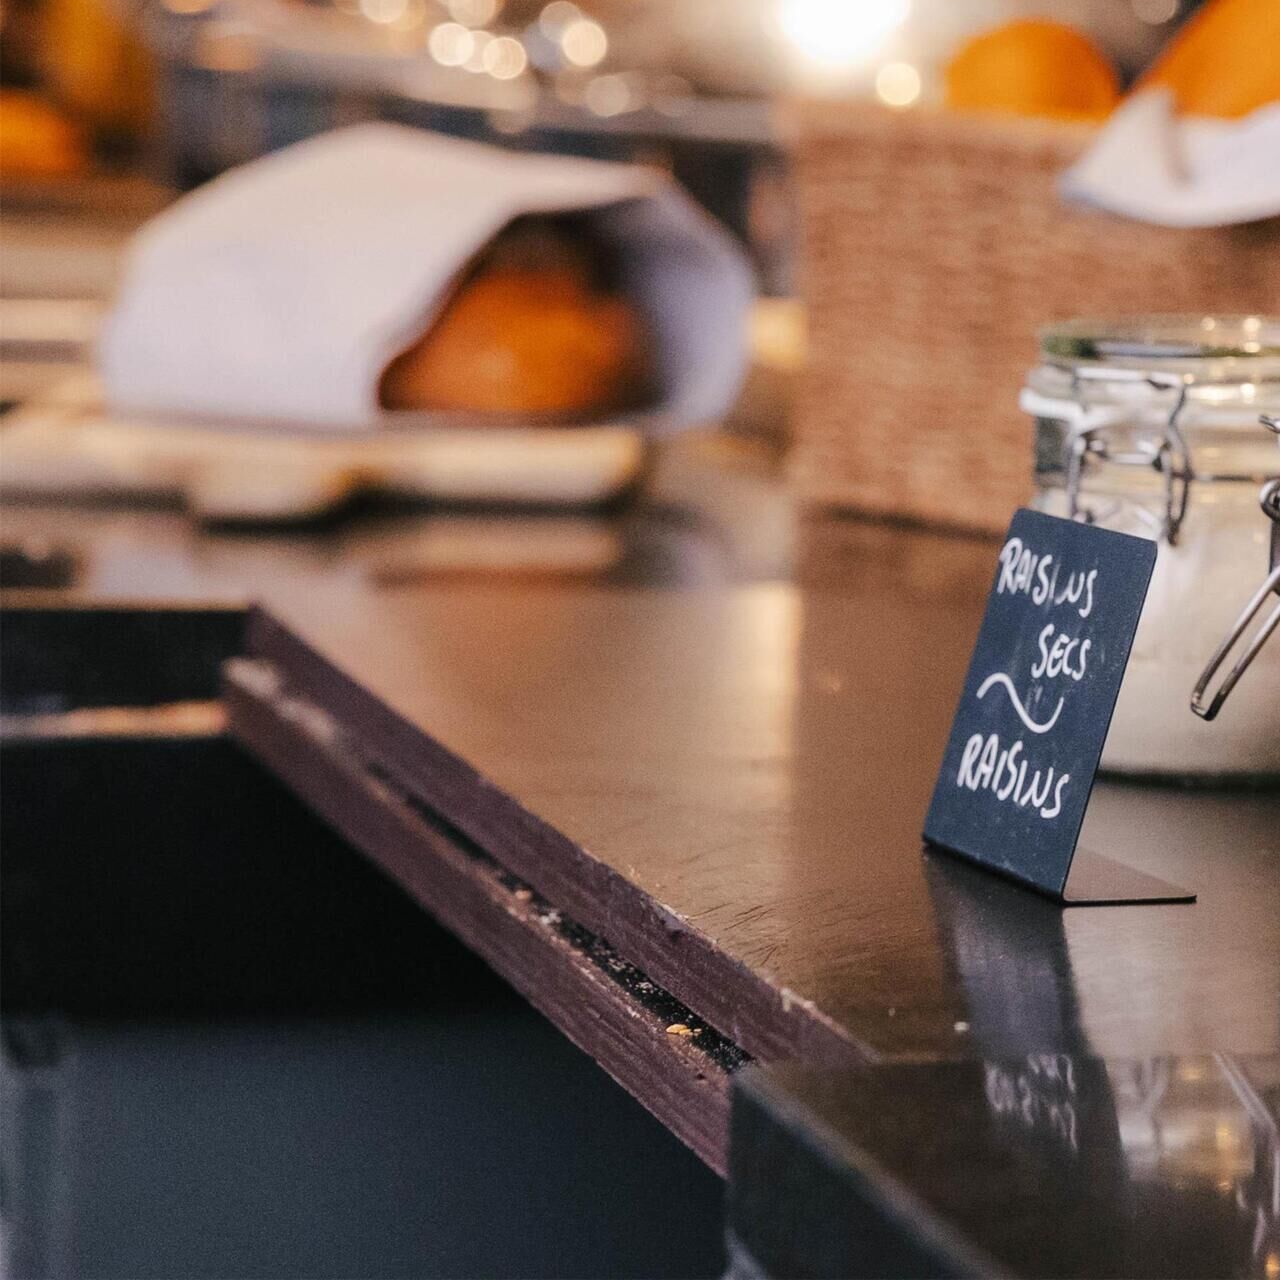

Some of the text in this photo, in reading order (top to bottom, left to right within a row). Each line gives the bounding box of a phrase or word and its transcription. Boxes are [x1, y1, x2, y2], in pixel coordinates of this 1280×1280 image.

[997, 537, 1098, 618] RAISINS
[1032, 623, 1092, 681] SECS
[956, 733, 1071, 819] RAISINS
